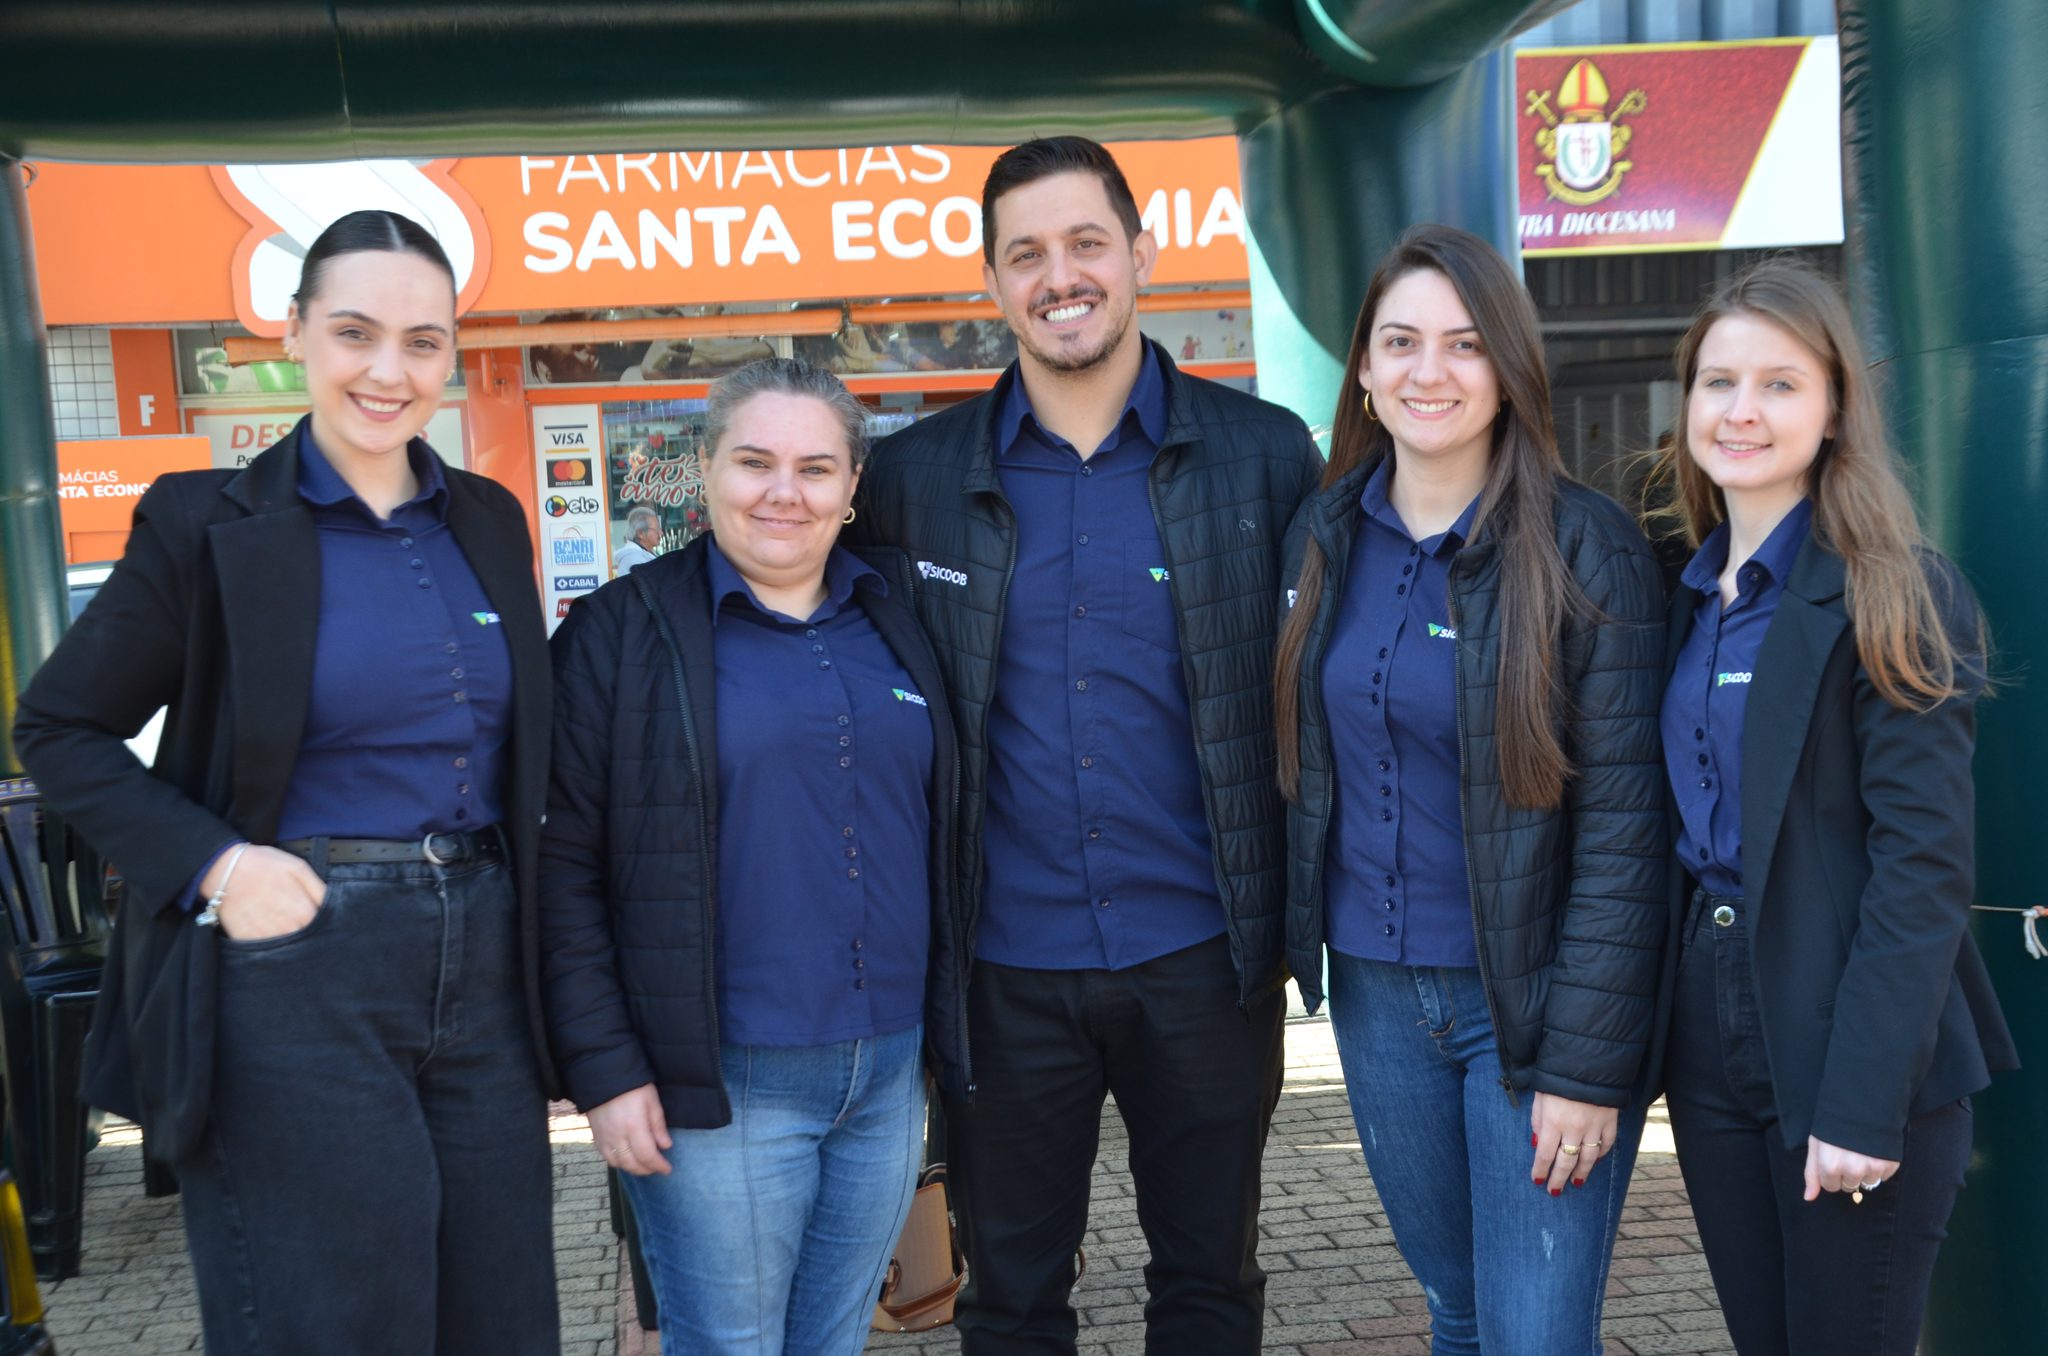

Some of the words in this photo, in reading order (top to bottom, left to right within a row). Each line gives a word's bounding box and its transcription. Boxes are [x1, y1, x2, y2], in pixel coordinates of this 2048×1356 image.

[522, 203, 801, 274] SANTA
[830, 186, 1247, 262] ECOMIA
[1517, 213, 1554, 238] TRA
[1559, 208, 1676, 237] DIOCESANA
[138, 394, 155, 427] F
[551, 432, 585, 446] VISA
[58, 468, 119, 484] MÁCIAS
[57, 485, 89, 498] NTA
[93, 482, 151, 498] ECONO
[567, 496, 600, 515] elo
[553, 539, 595, 555] BANRI
[554, 553, 596, 565] COMPRAS
[568, 578, 597, 588] CABAL
[929, 565, 968, 587] SICOOB
[1724, 671, 1753, 684] SICOO
